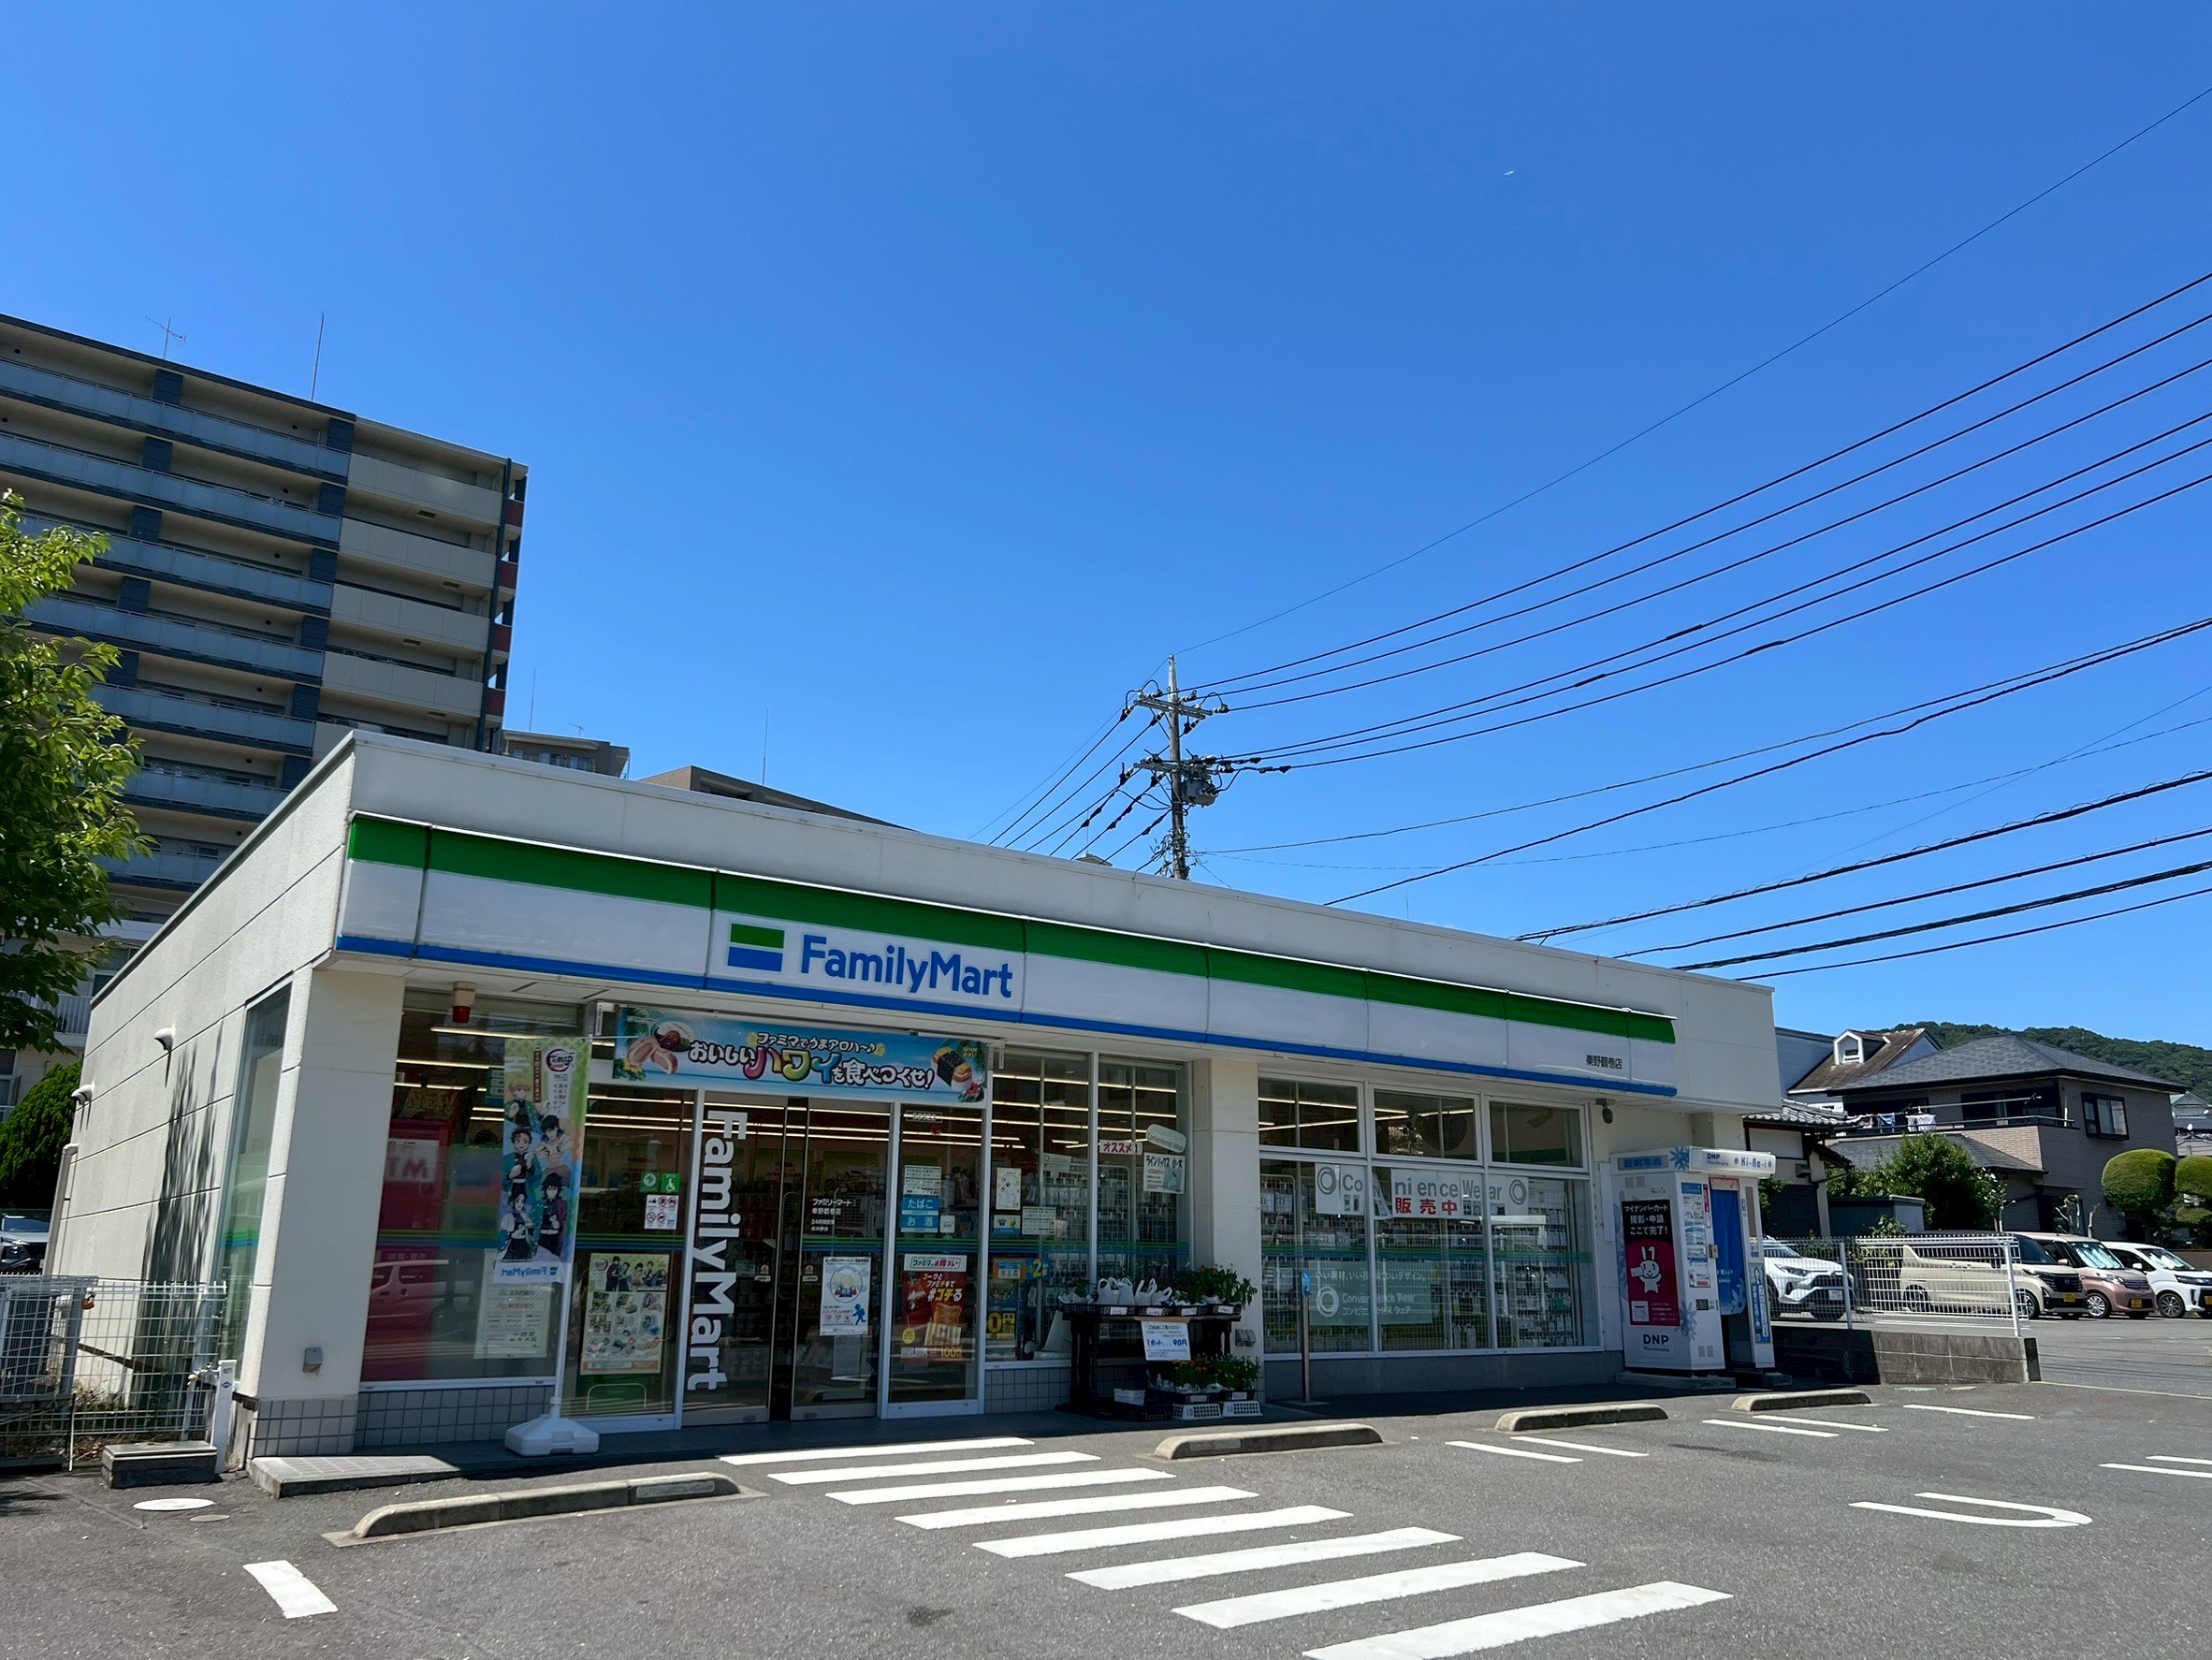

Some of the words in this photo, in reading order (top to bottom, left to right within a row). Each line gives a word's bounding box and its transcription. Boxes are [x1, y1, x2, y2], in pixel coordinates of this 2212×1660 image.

[801, 934, 1013, 998] FamilyMart
[812, 1198, 852, 1207] ファミリーマート
[908, 1199, 934, 1209] たばこ
[1395, 1197, 1458, 1216] 販売中
[1623, 1202, 1669, 1213] マイナンバーカード
[686, 1111, 748, 1391] FamilyMart
[1642, 1333, 1669, 1346] DNP
